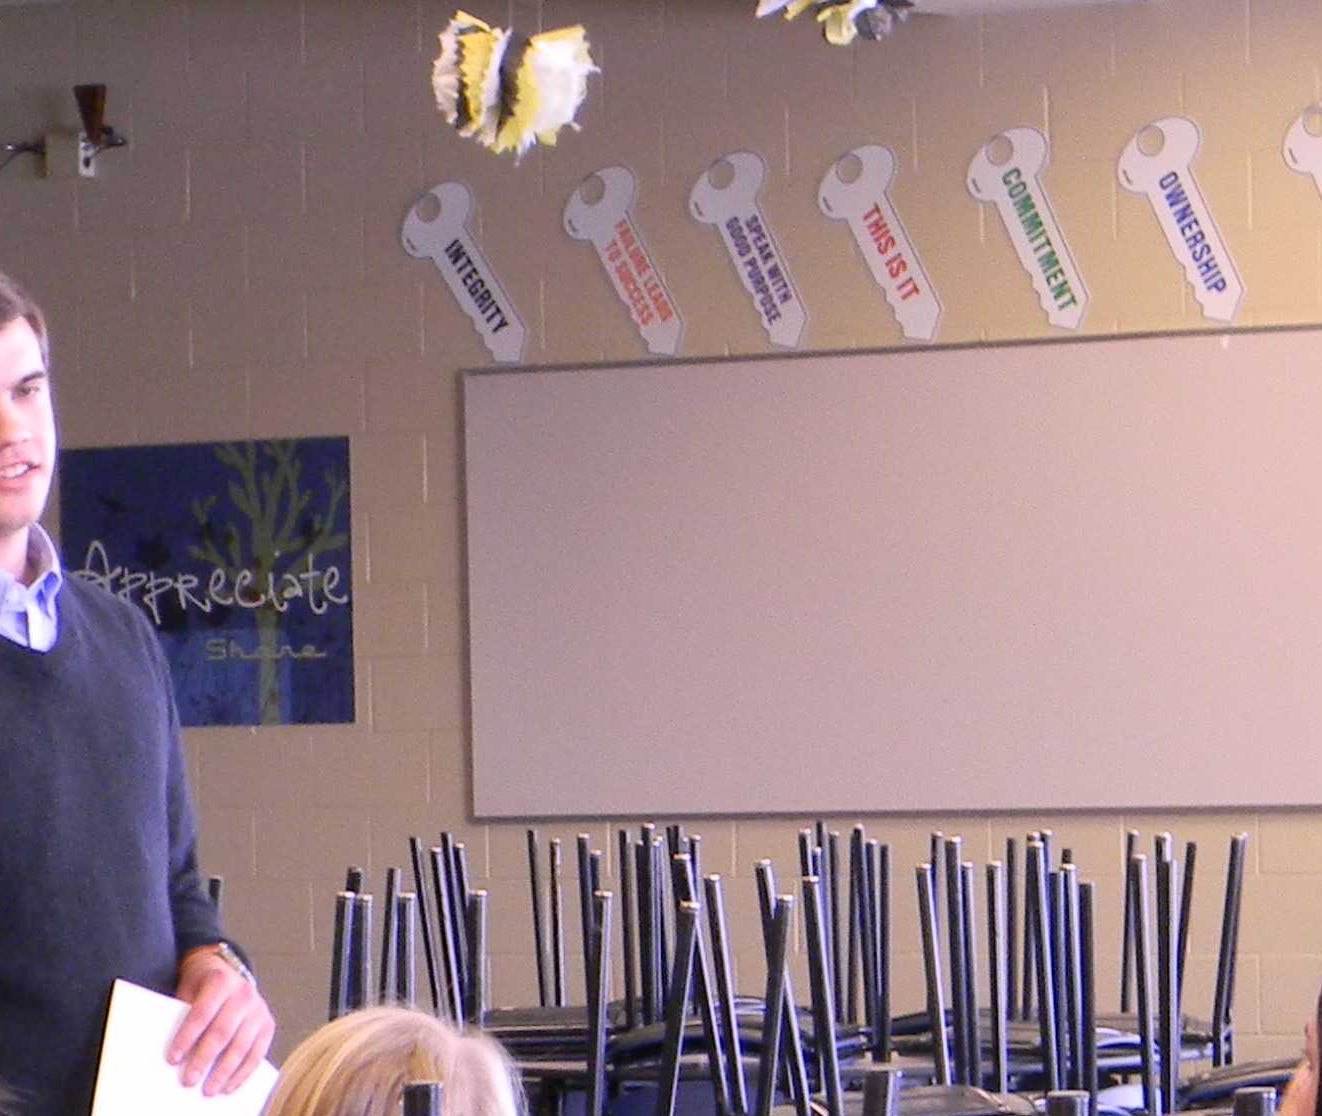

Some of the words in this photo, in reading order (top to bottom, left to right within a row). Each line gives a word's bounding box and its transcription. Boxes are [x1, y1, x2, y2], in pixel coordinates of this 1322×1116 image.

[726, 216, 751, 257] GOOD
[744, 256, 781, 325] PURPOSE
[745, 214, 774, 264] SPEAK
[767, 263, 793, 305] WITH
[863, 202, 896, 255] THIS
[885, 252, 908, 279] IS
[897, 276, 920, 300] IT
[1002, 167, 1077, 311] COMMITMENT
[1159, 171, 1226, 292] OWNERSHIP
[445, 239, 509, 333] INTEGRITY
[63, 540, 349, 626] Appreciate
[206, 640, 328, 661] Share
